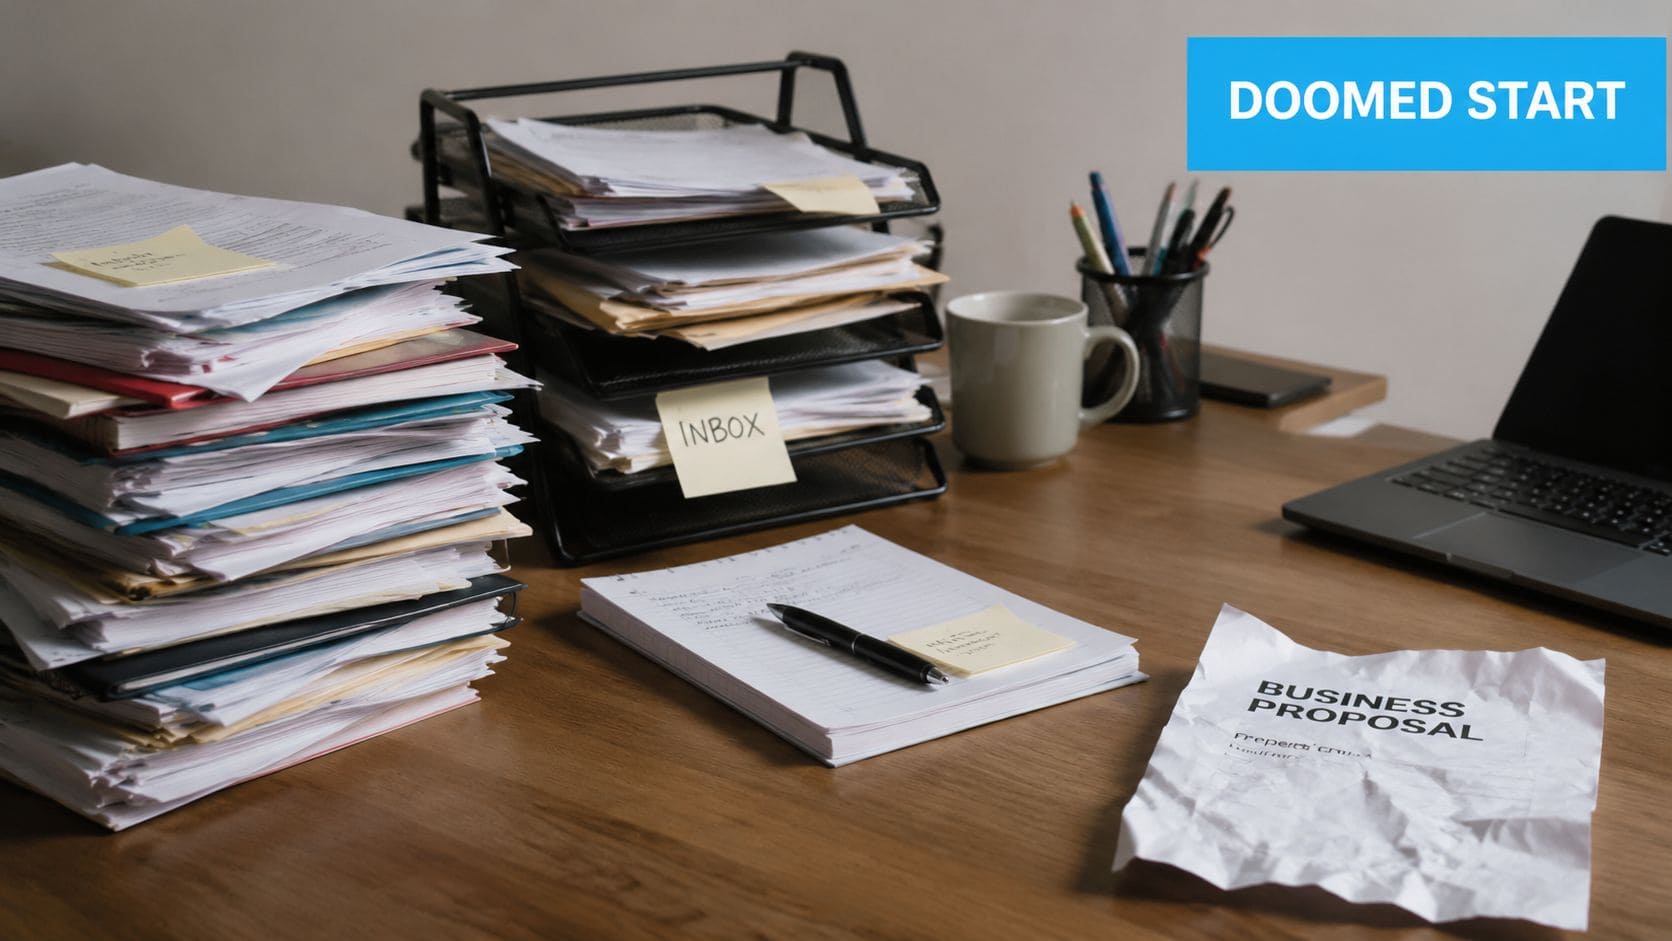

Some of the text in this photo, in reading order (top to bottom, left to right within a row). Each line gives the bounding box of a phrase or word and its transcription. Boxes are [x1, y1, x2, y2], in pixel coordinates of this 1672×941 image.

[679, 412, 765, 447] INBOX
[1256, 680, 1465, 718] BUSINESS
[1247, 697, 1484, 742] PROPOSAL
